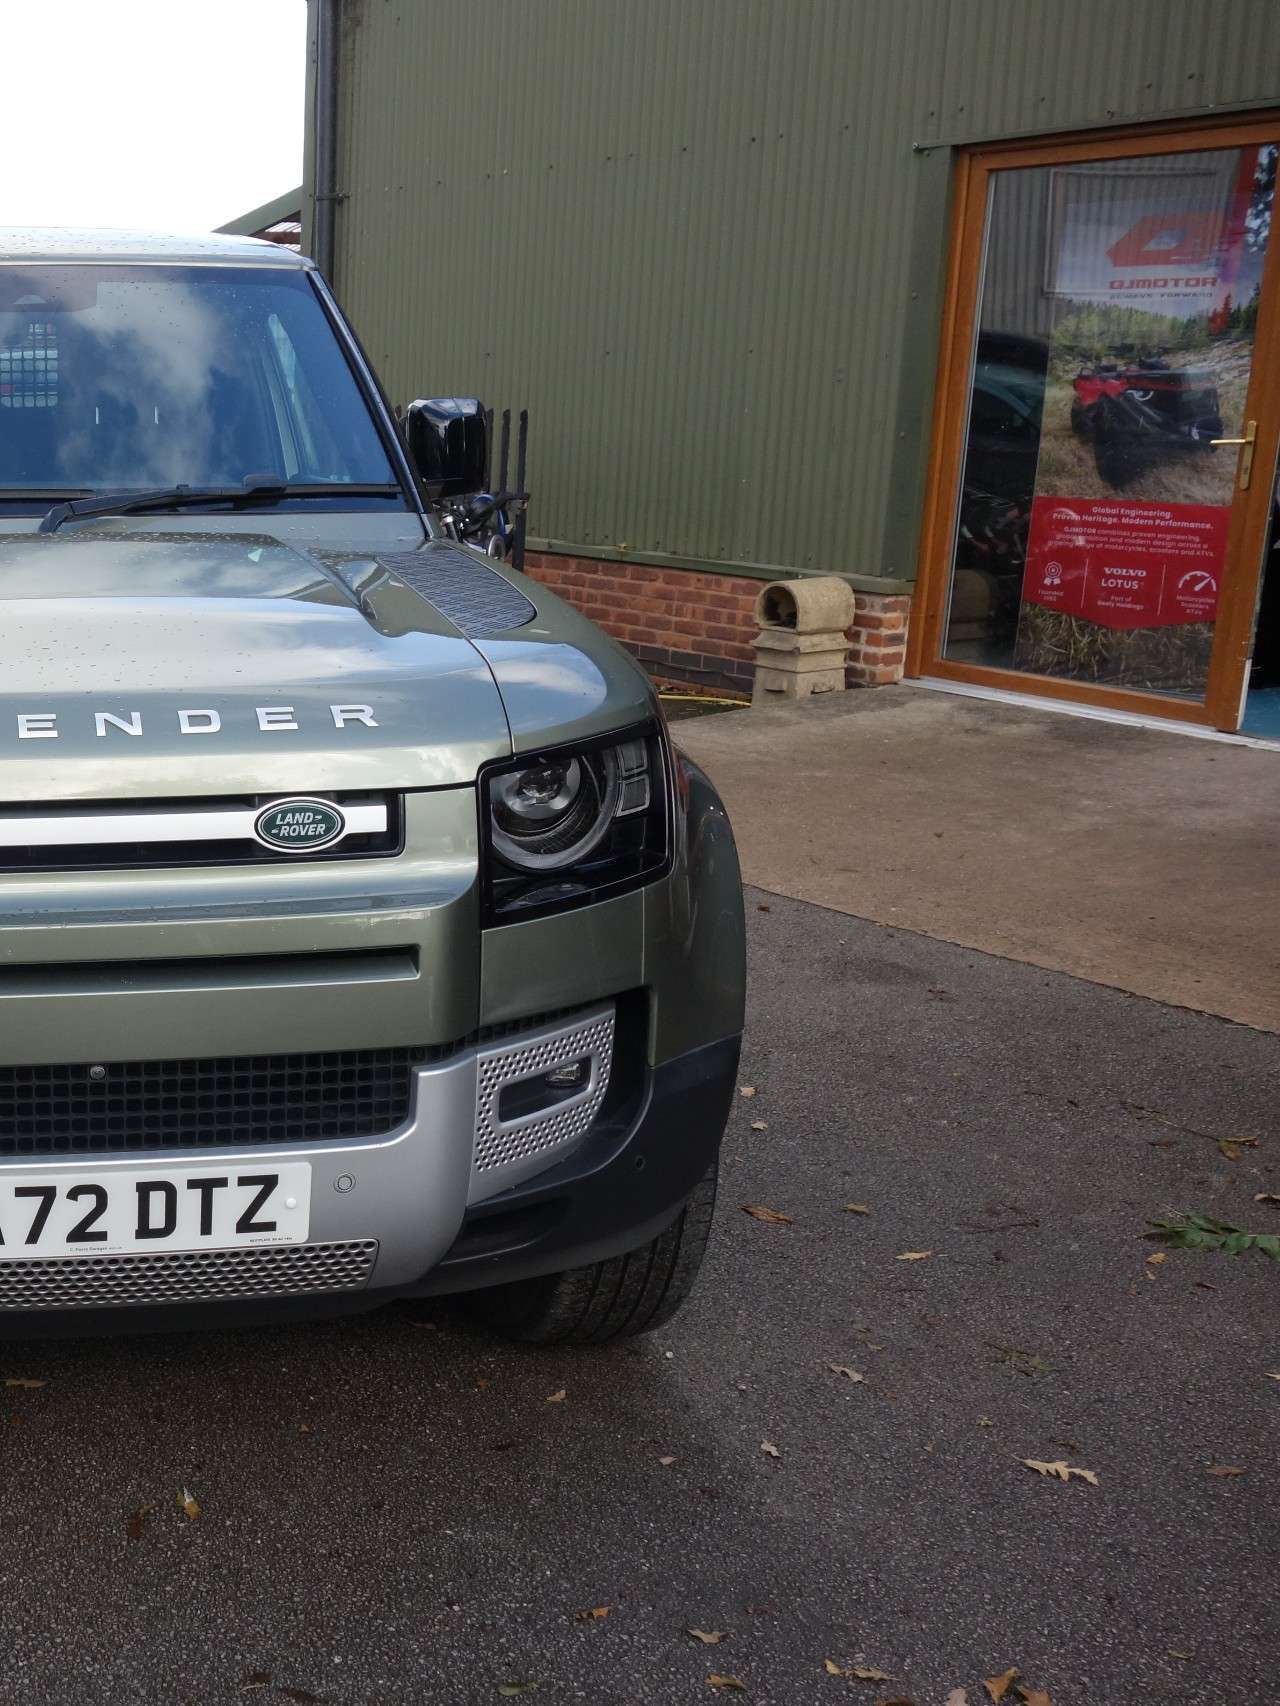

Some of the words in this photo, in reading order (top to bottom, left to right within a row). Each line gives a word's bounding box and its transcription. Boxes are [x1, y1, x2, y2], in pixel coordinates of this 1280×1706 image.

[1092, 506, 1119, 514] Global
[1120, 507, 1173, 518] Engineering.
[1053, 513, 1080, 521] Proven
[1122, 518, 1154, 526] Modern
[1104, 567, 1147, 577] VOLVO
[1101, 578, 1139, 589] LOTUS
[134, 1173, 280, 1240] DTZ
